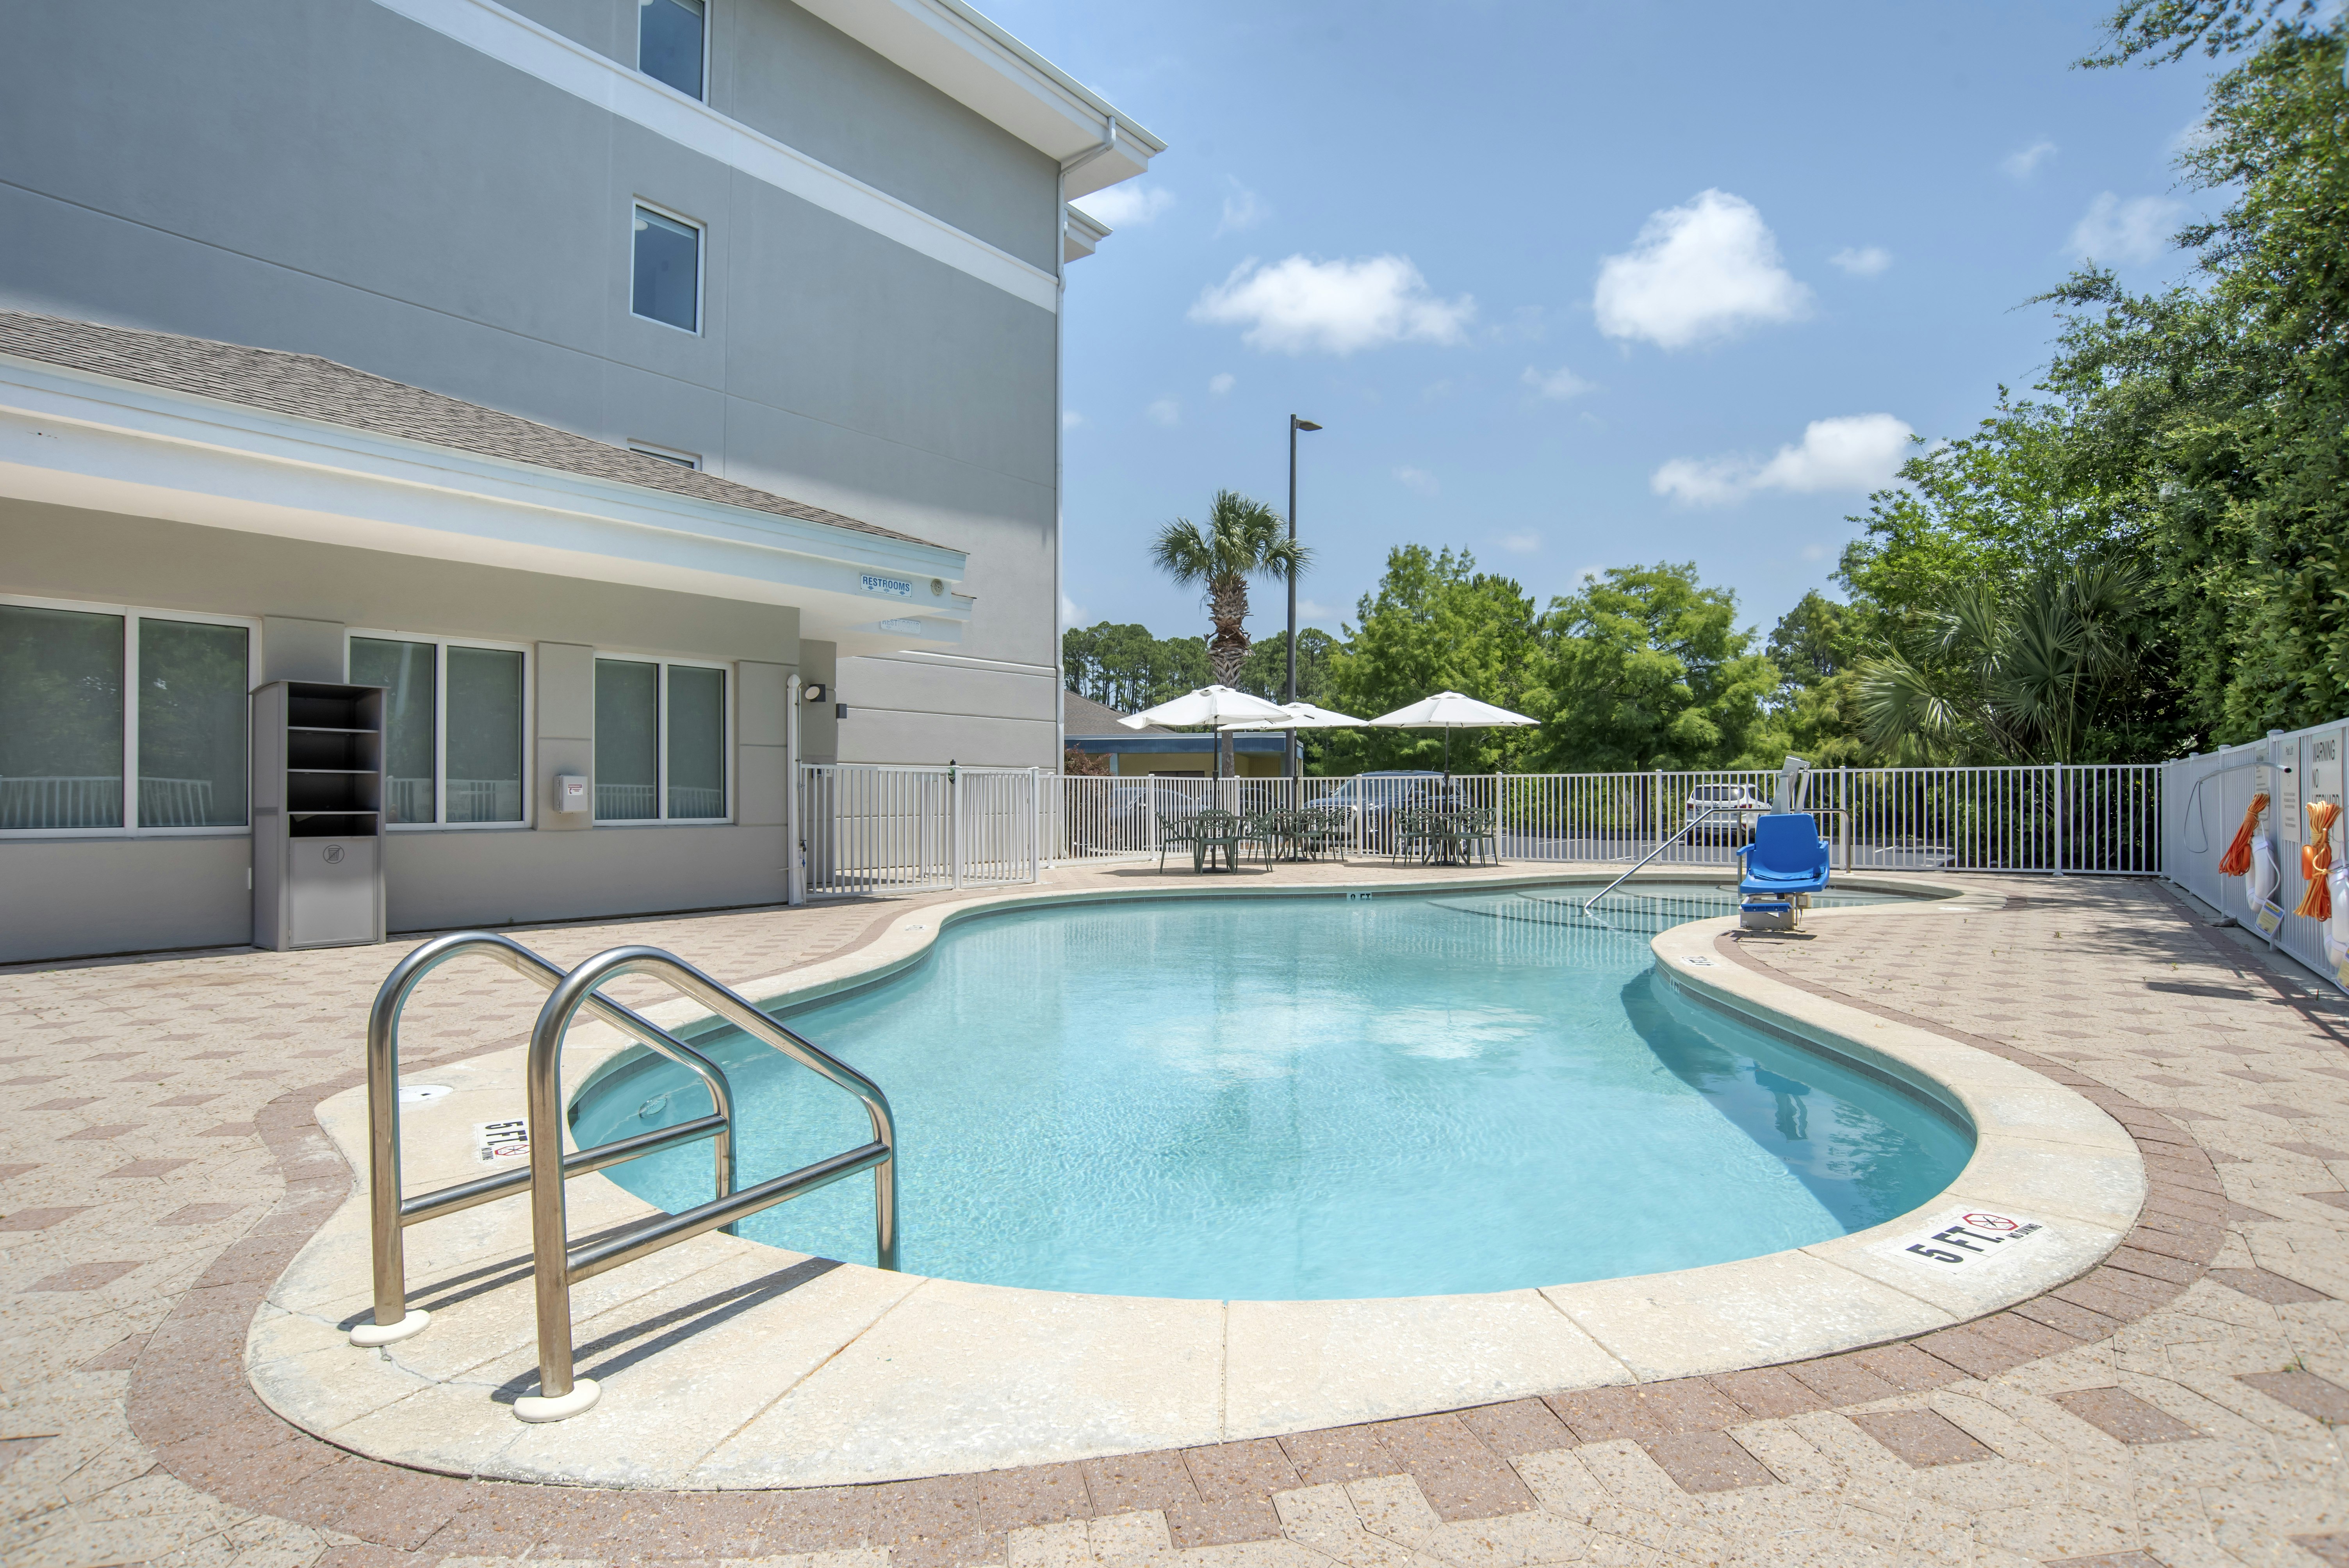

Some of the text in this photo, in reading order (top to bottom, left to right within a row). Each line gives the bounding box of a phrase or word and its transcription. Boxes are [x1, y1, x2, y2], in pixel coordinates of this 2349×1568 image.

[863, 576, 910, 592] RESTROOMS
[2313, 739, 2335, 763] WARNING
[2312, 768, 2319, 788] NO
[485, 1121, 523, 1130] 5
[2014, 1223, 2042, 1235] DIVING
[1905, 1226, 2005, 1263] 5 FT.
